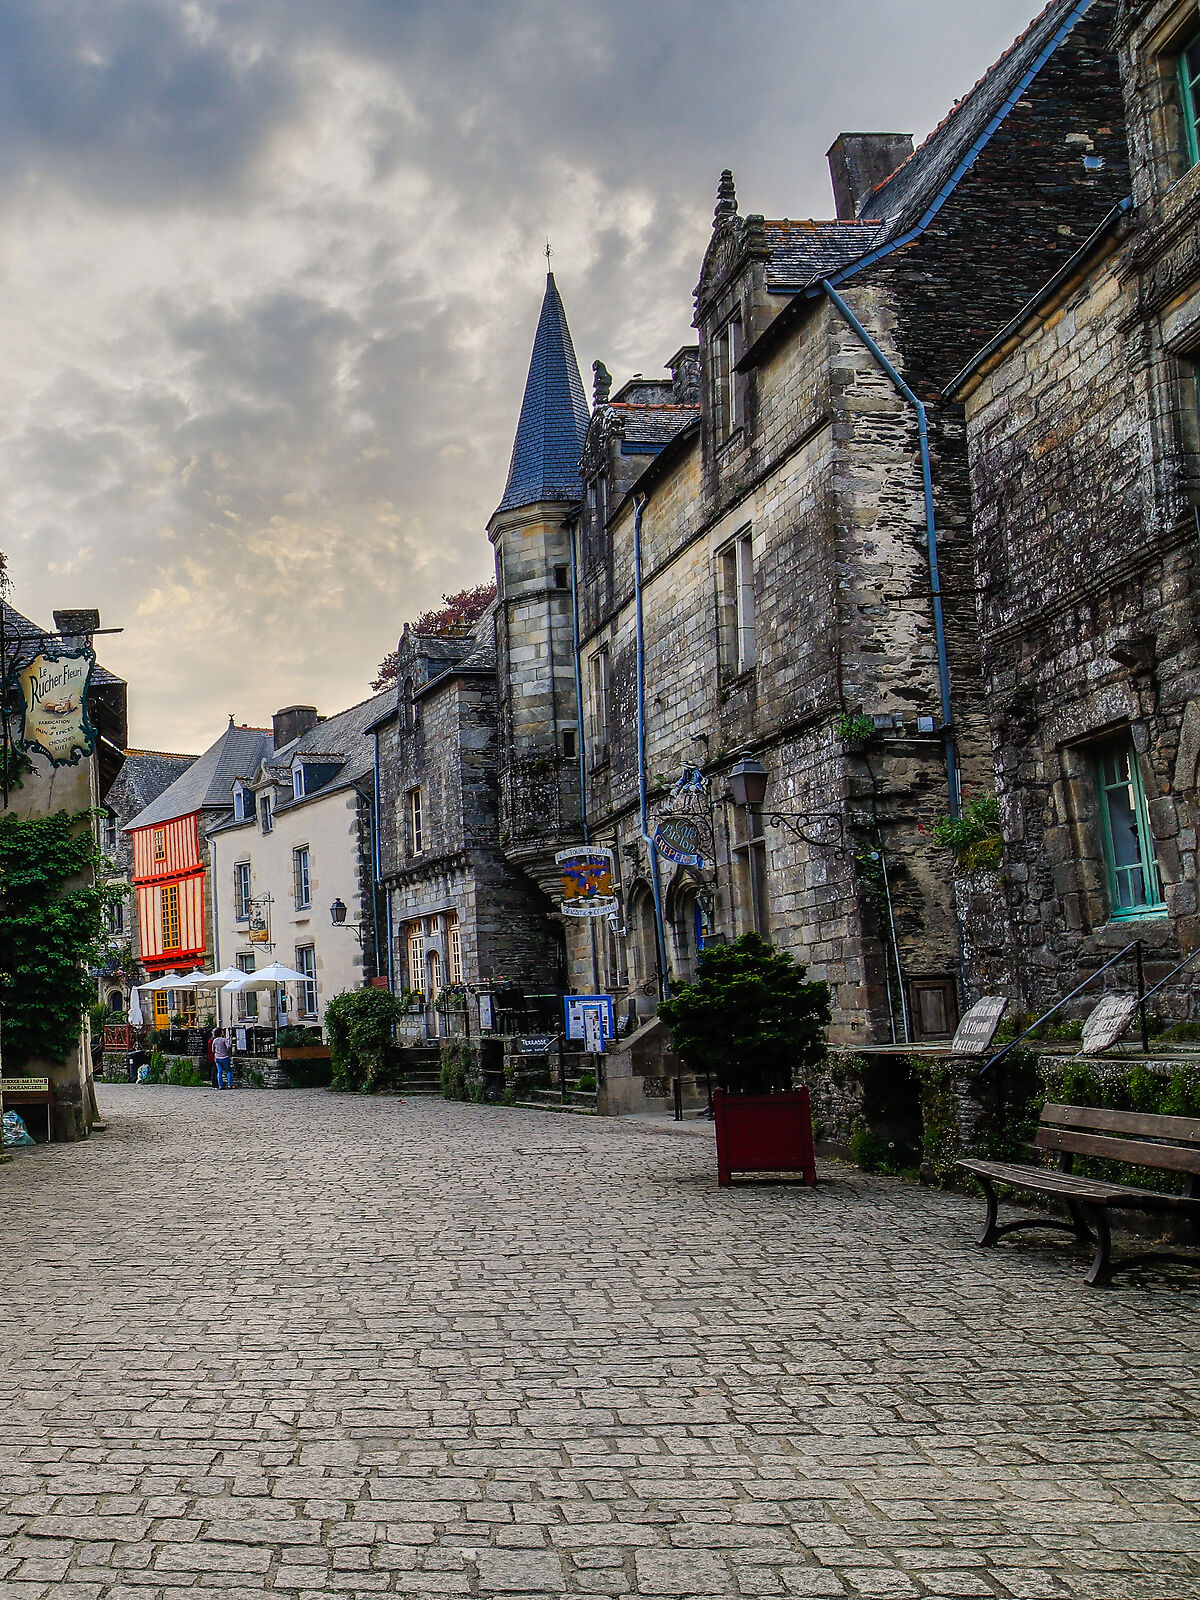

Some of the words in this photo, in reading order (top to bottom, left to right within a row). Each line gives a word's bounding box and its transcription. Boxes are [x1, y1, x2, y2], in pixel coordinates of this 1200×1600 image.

[39, 666, 48, 679] Le
[63, 664, 82, 686] Fleuri
[29, 672, 63, 713] Rucher
